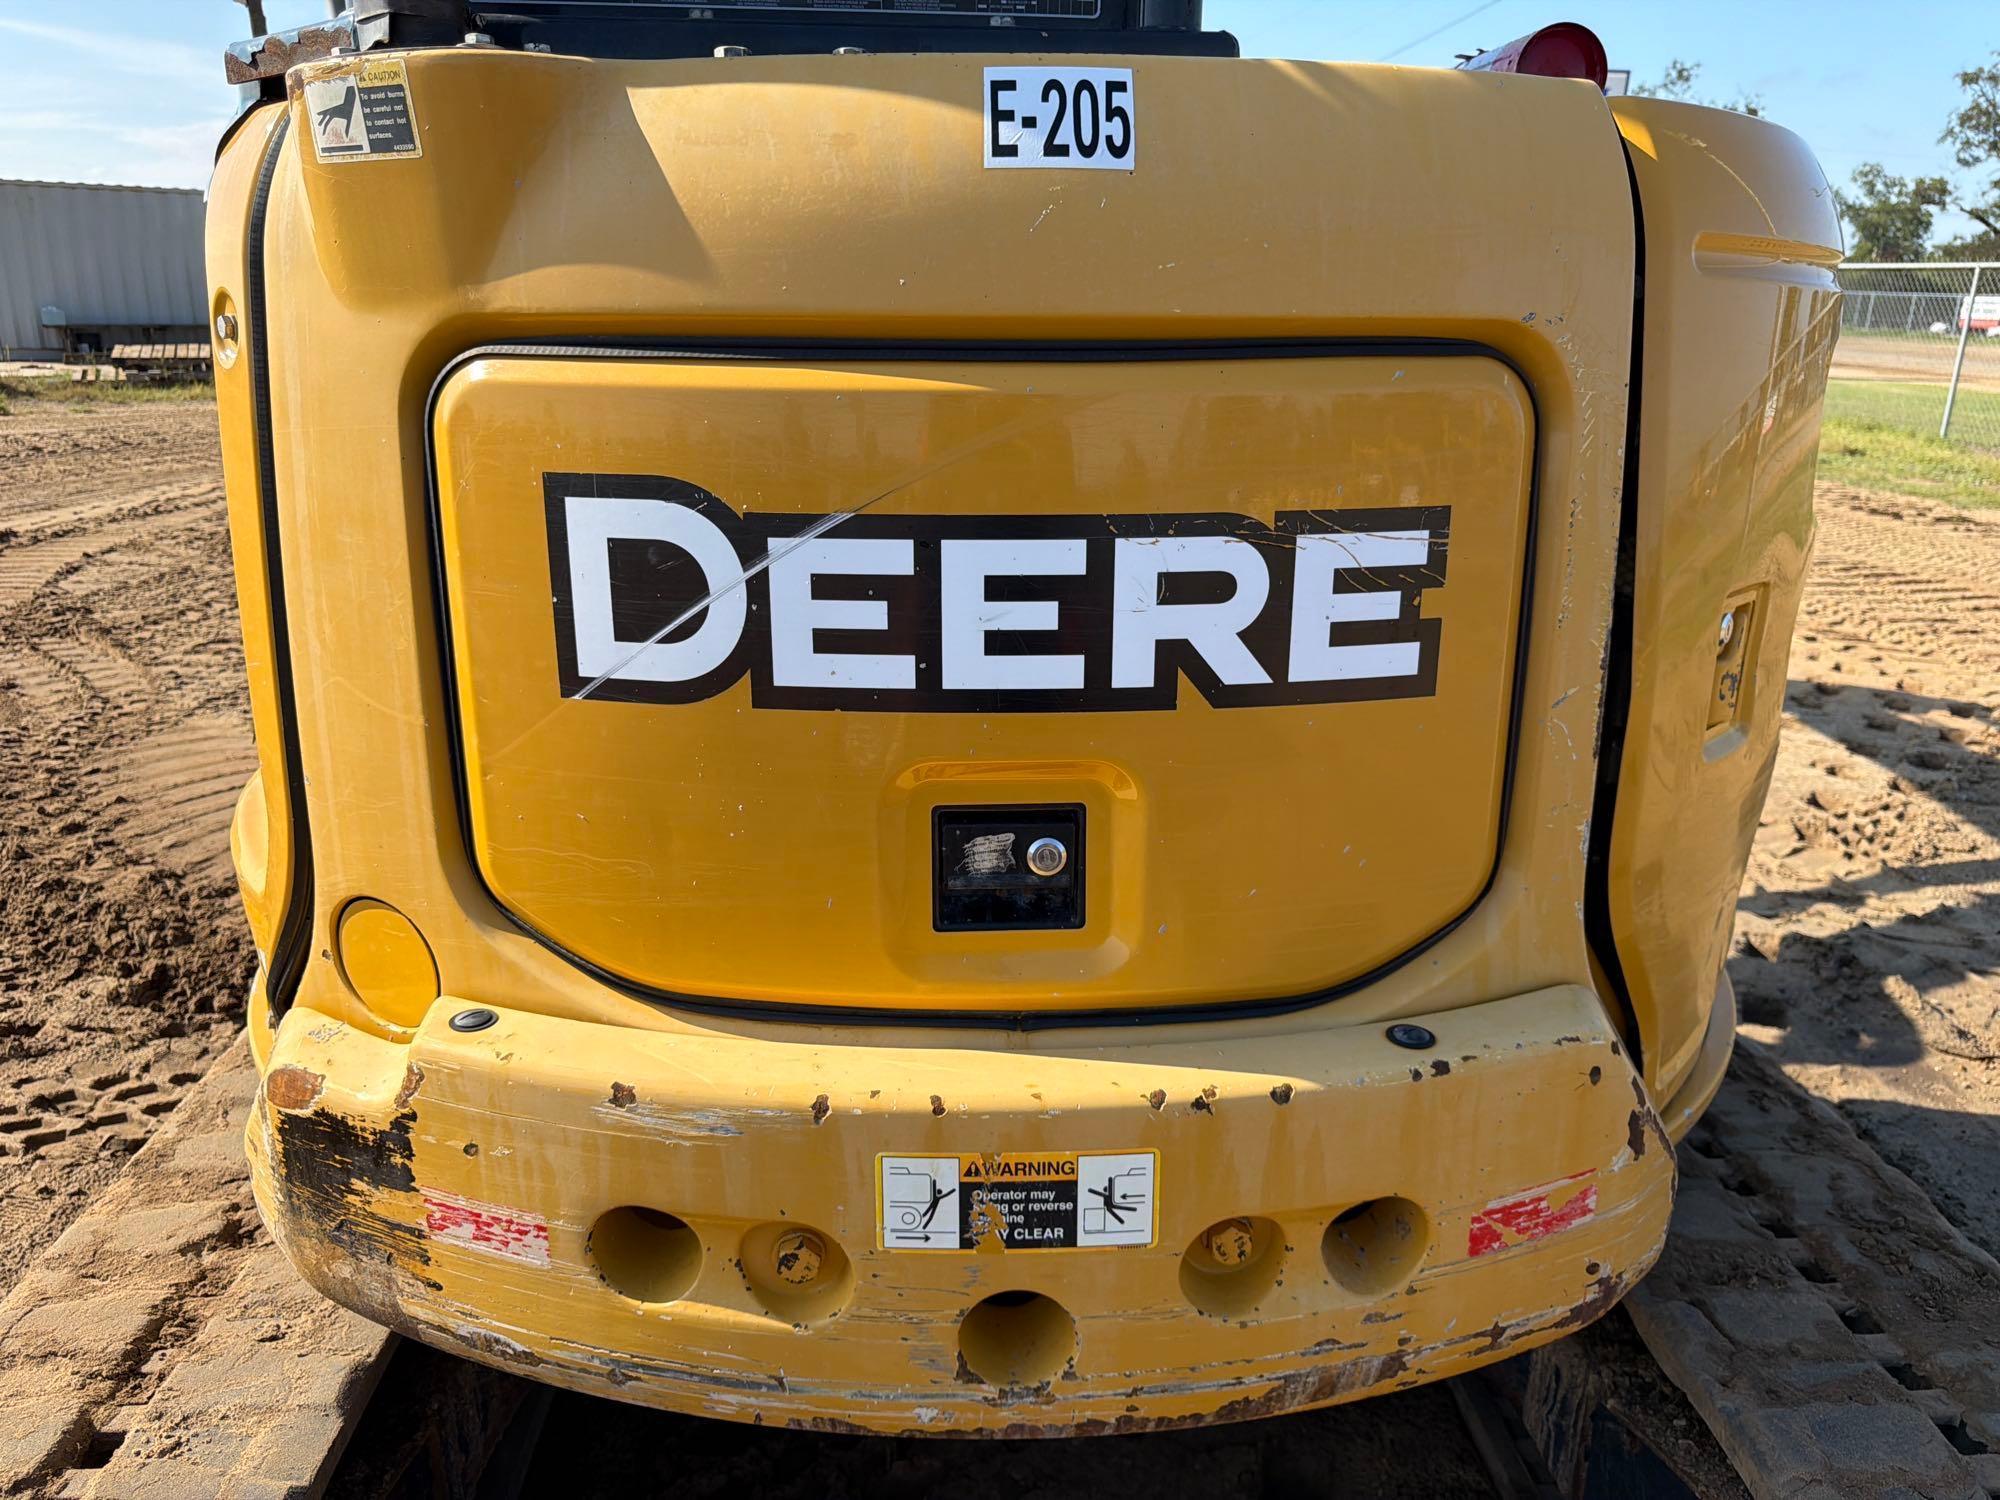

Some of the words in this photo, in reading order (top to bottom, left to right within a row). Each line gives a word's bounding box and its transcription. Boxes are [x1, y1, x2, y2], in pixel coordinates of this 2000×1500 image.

[367, 70, 401, 81] CAUTION
[370, 91, 386, 100] avoid
[374, 118, 395, 126] contact
[990, 79, 1131, 159] E-205
[564, 497, 1430, 690] DEERE
[982, 1160, 1076, 1177] WARNING
[972, 1189, 1027, 1203] Operator
[1030, 1191, 1056, 1201] may
[1012, 1203, 1025, 1211] or
[1028, 1201, 1074, 1211] reverse
[1013, 1227, 1064, 1240] CLEAR
